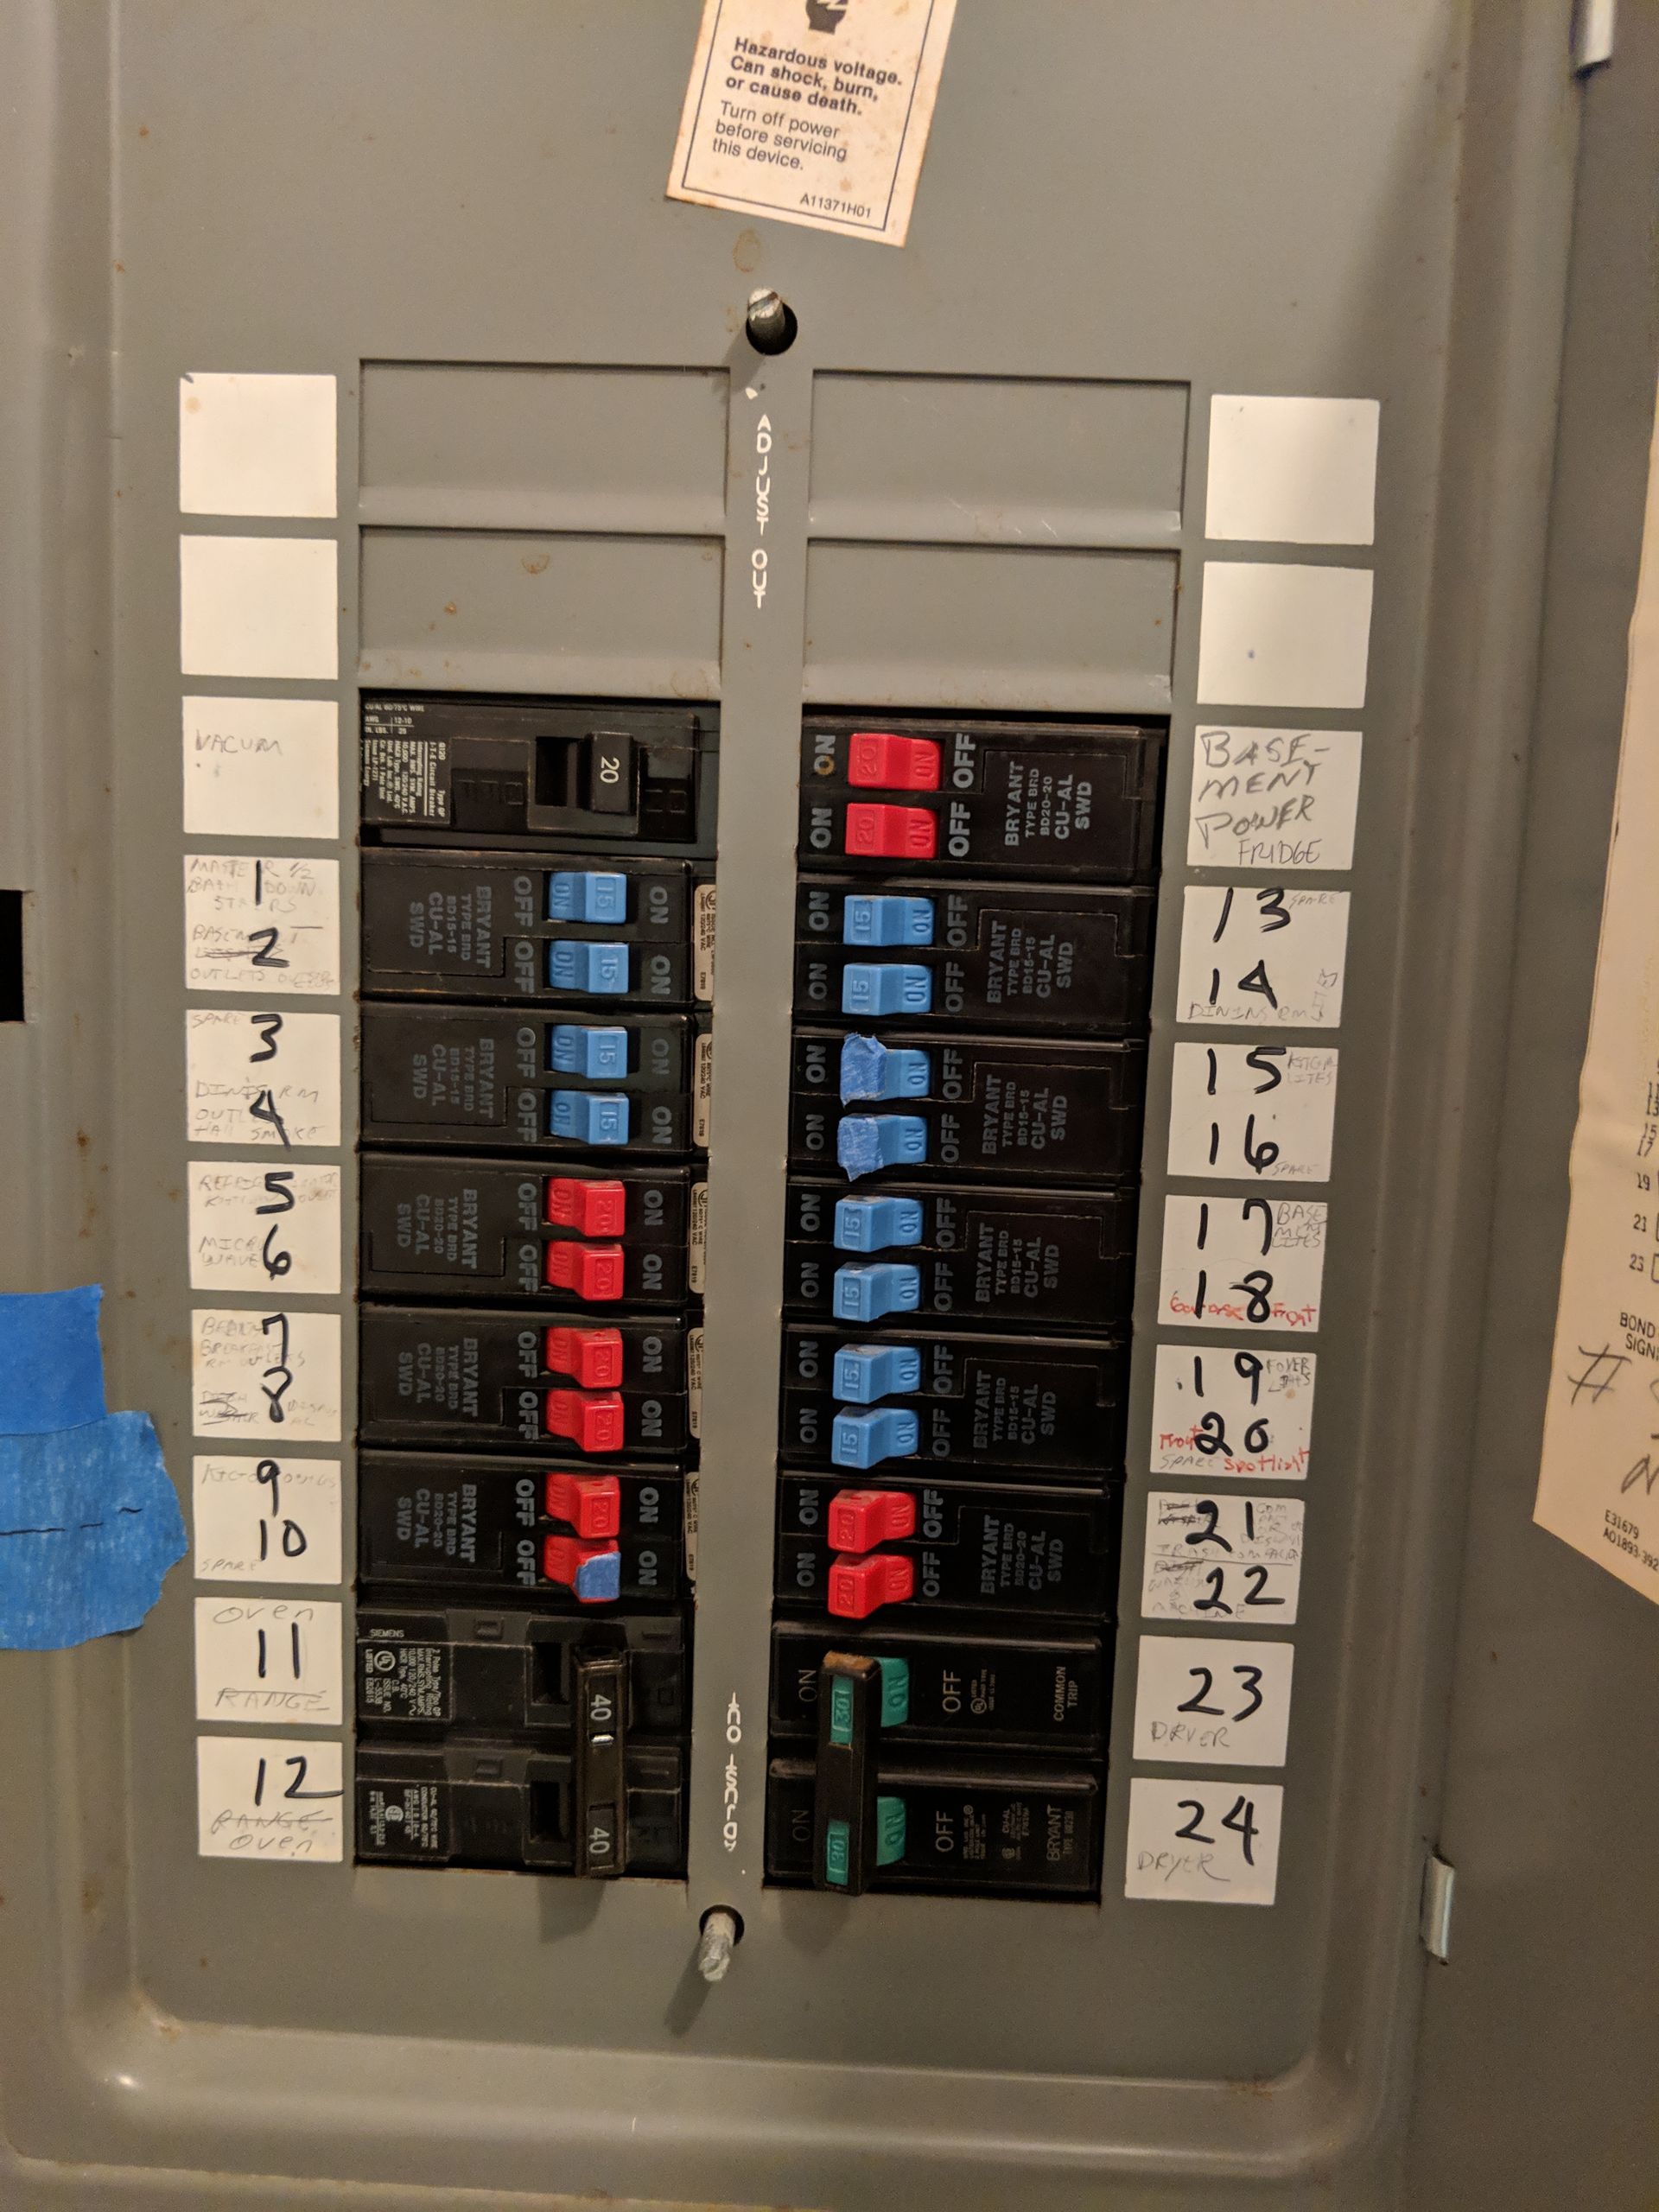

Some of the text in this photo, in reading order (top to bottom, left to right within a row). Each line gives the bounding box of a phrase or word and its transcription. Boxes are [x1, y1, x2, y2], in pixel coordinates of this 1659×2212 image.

[731, 56, 878, 102] Can shock, burn,
[734, 36, 902, 86] Hazardous voltage.
[721, 100, 840, 139] Turn off power
[725, 77, 862, 116] or cause death.
[712, 138, 804, 171] this device.
[715, 120, 848, 163] before servicing
[800, 194, 871, 218] A11371H01
[752, 414, 772, 608] ADJUST OUT
[600, 757, 620, 783] 20
[814, 734, 836, 776] ON
[953, 733, 977, 788] OFF
[1200, 730, 1330, 768] BASE-
[1005, 761, 1024, 847] BRYANT
[1025, 768, 1039, 838] TYPE BRD
[1075, 781, 1092, 830] SWD
[1198, 760, 1322, 803] MENT
[810, 806, 832, 849] ON
[949, 801, 971, 857] OFF
[1055, 773, 1073, 840] CU-AL
[1194, 795, 1316, 849] POWER
[1238, 838, 1323, 866] FRIDGE
[255, 860, 262, 905] 1
[512, 876, 533, 928] OFF
[649, 887, 668, 925] ON
[409, 902, 424, 948] SWD
[474, 886, 492, 969] BRYANT
[809, 891, 830, 931] ON
[946, 894, 968, 948] OFF
[1212, 887, 1291, 943] 13
[249, 927, 290, 968] 2
[515, 942, 534, 993] OFF
[987, 921, 1007, 1004] BRYANT
[1037, 934, 1056, 998] CU-AL
[1056, 942, 1073, 988] SWD
[652, 956, 671, 995] ON
[809, 963, 828, 1001] ON
[945, 961, 965, 1013] OFF
[1209, 959, 1278, 1009] 14
[251, 1014, 283, 1063] 3
[517, 1027, 536, 1078] OFF
[652, 1039, 669, 1075] ON
[479, 1039, 494, 1119] BRYANT
[805, 1045, 827, 1084] ON
[943, 1049, 963, 1100] OFF
[1207, 1046, 1287, 1095] 15
[250, 1090, 291, 1152] 4
[517, 1092, 537, 1142] OFF
[652, 1106, 671, 1145] ON
[805, 1114, 824, 1151] ON
[941, 1113, 961, 1164] OFF
[982, 1075, 1002, 1154] BRYANT
[1032, 1088, 1049, 1150] CU-AL
[1051, 1096, 1068, 1141] SWD
[1643, 1123, 1657, 1141] 15
[1209, 1114, 1280, 1175] 16
[1637, 1141, 1653, 1158] 17
[256, 1171, 296, 1215] 5
[518, 1182, 537, 1231] OFF
[1637, 1173, 1650, 1191] 19
[461, 1189, 479, 1269] BRYANT
[644, 1190, 663, 1226] ON
[800, 1194, 821, 1232] ON
[936, 1198, 957, 1249] OFF
[1197, 1198, 1273, 1256] 17
[1633, 1214, 1646, 1232] 21
[263, 1224, 292, 1281] 6
[518, 1244, 538, 1293] OFF
[643, 1254, 663, 1291] ON
[976, 1224, 994, 1303] BRYANT
[1024, 1236, 1042, 1298] CU-AL
[1044, 1244, 1059, 1288] SWD
[1630, 1254, 1643, 1272] 23
[800, 1262, 819, 1298] ON
[934, 1262, 954, 1312] OFF
[1195, 1270, 1274, 1323] 18
[262, 1313, 289, 1367] 7
[1620, 1312, 1655, 1338] BOND
[463, 1338, 478, 1417] BRYANT
[518, 1331, 537, 1379] OFF
[643, 1337, 663, 1374] ON
[798, 1341, 818, 1378] ON
[934, 1344, 954, 1395] OFF
[1194, 1351, 1263, 1406] 19
[260, 1365, 293, 1423] 8
[518, 1391, 538, 1440] OFF
[973, 1370, 992, 1449] BRYANT
[641, 1401, 662, 1439] ON
[799, 1408, 817, 1444] ON
[932, 1409, 950, 1458] OFF
[257, 1459, 280, 1517] 9
[516, 1478, 535, 1527] OFF
[639, 1487, 658, 1523] ON
[798, 1490, 819, 1525] ON
[461, 1484, 477, 1562] BRYANT
[923, 1490, 944, 1538] OFF
[1185, 1499, 1255, 1552] 21
[1605, 1510, 1639, 1539] E31679
[259, 1519, 307, 1560] 10
[517, 1540, 536, 1586] OFF
[980, 1515, 1000, 1595] BRYANT
[1028, 1530, 1046, 1591] CU-AL
[1047, 1538, 1065, 1582] SWD
[639, 1551, 658, 1586] ON
[797, 1553, 816, 1587] ON
[923, 1552, 941, 1598] OFF
[1193, 1565, 1286, 1615] 22
[258, 1622, 300, 1679] 11
[370, 1629, 404, 1638] SIEMENS
[589, 1694, 611, 1720] 40
[798, 1669, 817, 1702] ON
[942, 1670, 962, 1713] OFF
[1053, 1667, 1066, 1721] COMMON
[1067, 1681, 1078, 1707] TRIP
[1177, 1665, 1262, 1722] 23
[254, 1756, 345, 1807] 12
[723, 1692, 741, 1852] ADJUST OUT
[588, 1827, 610, 1854] 40
[791, 1809, 811, 1842] ON
[936, 1811, 954, 1853] OFF
[1046, 1804, 1062, 1861] BRYANT
[1175, 1796, 1259, 1866] 24
